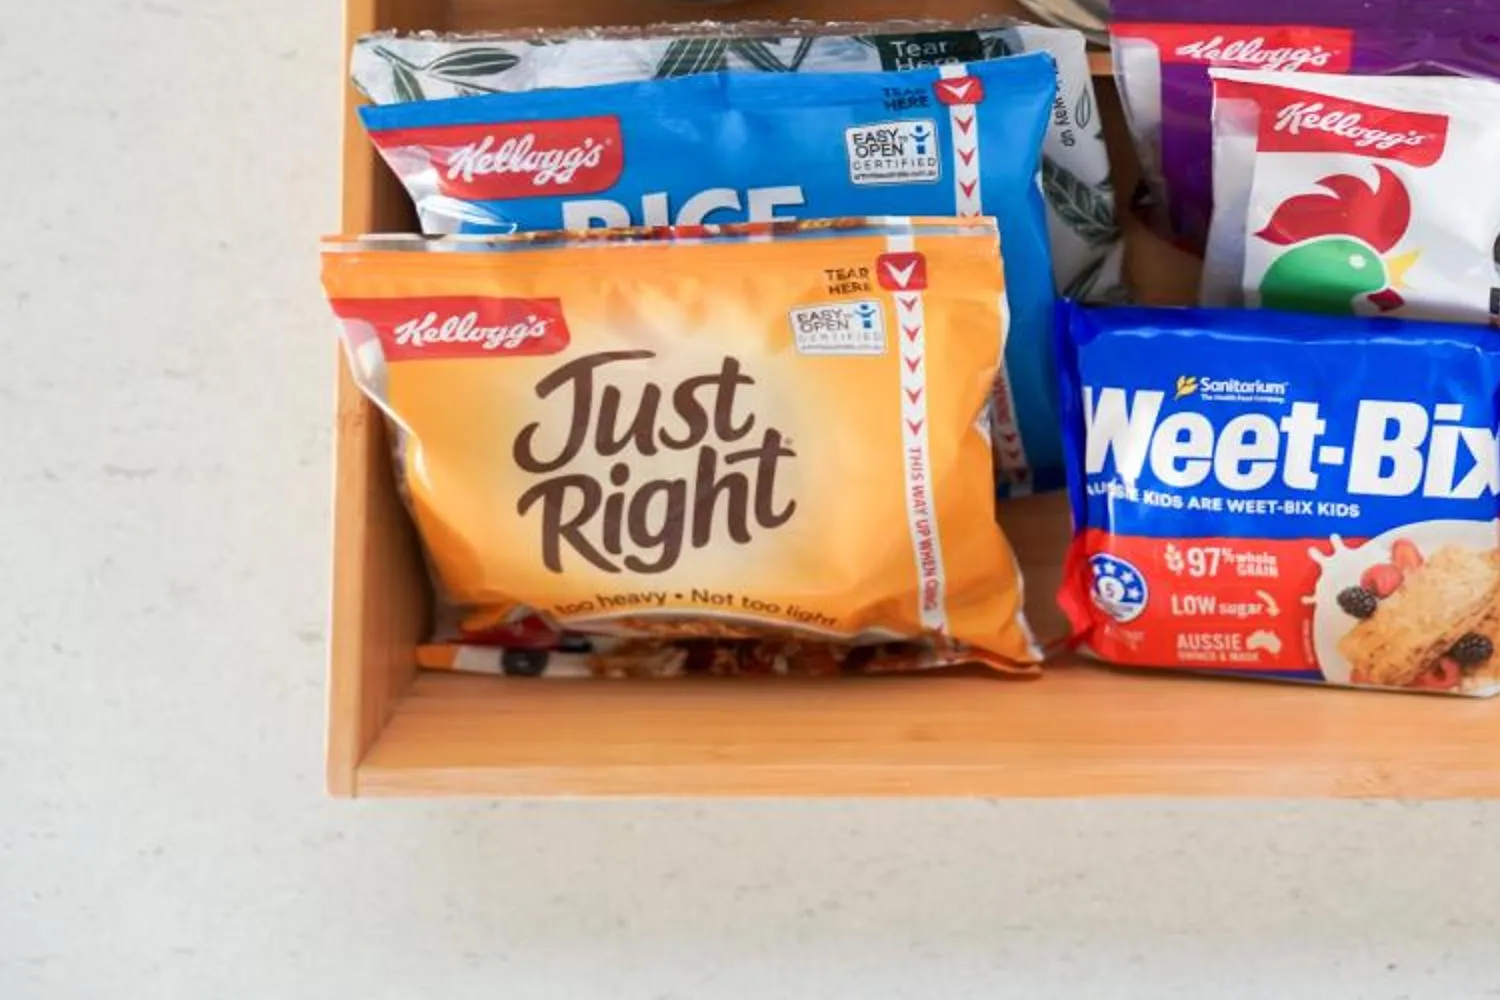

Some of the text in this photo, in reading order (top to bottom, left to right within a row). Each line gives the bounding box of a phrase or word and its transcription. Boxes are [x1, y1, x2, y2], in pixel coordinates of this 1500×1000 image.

[889, 39, 948, 58] Tear
[1175, 36, 1331, 73] Kellogg's
[853, 128, 899, 145] EASY
[1274, 102, 1424, 149] Kellogg's
[447, 132, 603, 186] Kellogg's
[853, 157, 936, 171] CERTIFIED
[855, 143, 905, 159] OPEN
[825, 267, 869, 281] TEAR
[394, 311, 549, 349] Kellogg's
[512, 349, 756, 473] Just
[516, 427, 798, 575] Right
[1143, 490, 1361, 519] KIDS ARE WEET-BIX KIDS
[596, 590, 667, 608] heavy
[691, 588, 734, 606] Not
[741, 594, 781, 614] too
[1171, 594, 1217, 616] LOW
[1176, 633, 1242, 651] AUSSIE
